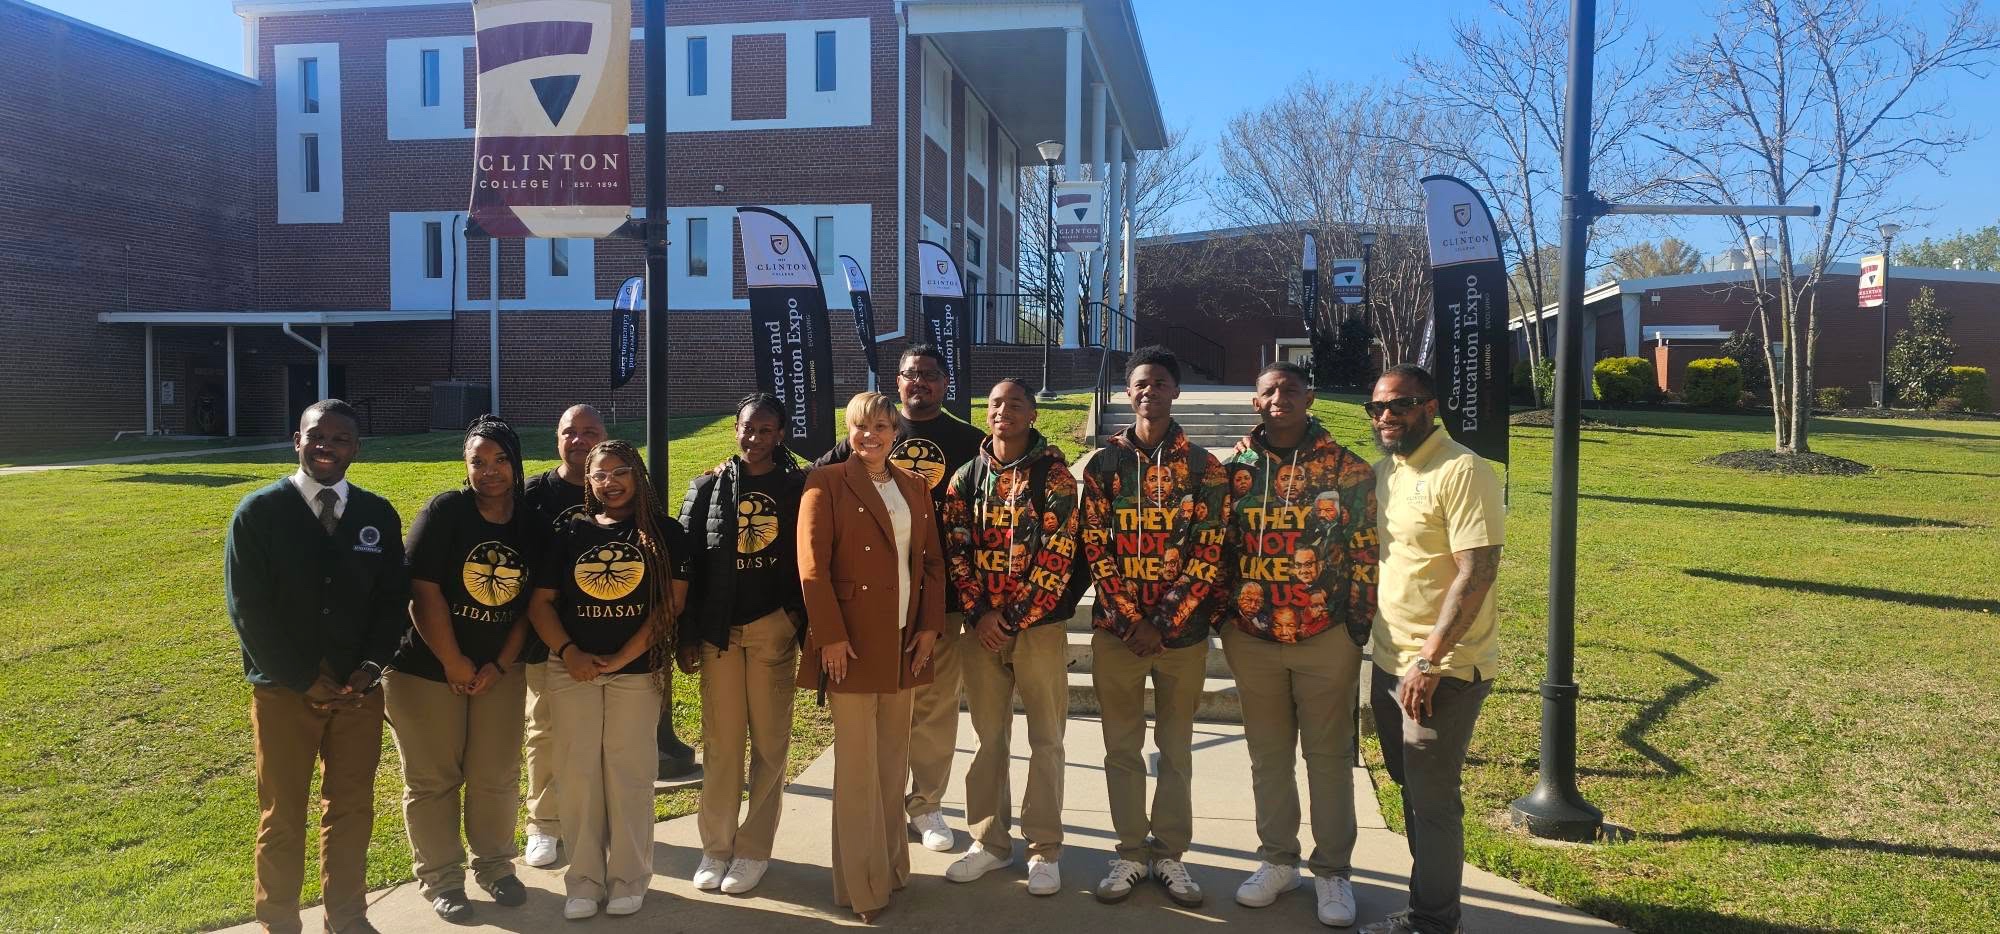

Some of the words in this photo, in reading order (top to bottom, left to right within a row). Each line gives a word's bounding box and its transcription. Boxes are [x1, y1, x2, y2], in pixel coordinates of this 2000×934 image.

[479, 154, 619, 171] CLINTON
[480, 180, 550, 189] COLLEGE
[1442, 234, 1490, 247] CLINTON
[757, 263, 808, 271] CLINTON
[1464, 274, 1482, 326] Expo
[786, 298, 803, 344] Expo
[944, 304, 954, 336] Expo
[1448, 302, 1462, 339] and
[621, 314, 630, 355] Education
[765, 320, 782, 354] and
[772, 358, 786, 405] areer
[1448, 346, 1461, 411] Career
[1462, 332, 1478, 432] Education
[788, 348, 807, 438] Education
[1116, 508, 1180, 530] THEY
[1243, 506, 1312, 530] THEY
[1116, 532, 1170, 556] NOT
[1244, 532, 1302, 555] NOT
[1124, 556, 1162, 580] IKE
[1239, 554, 1291, 582] LIKE
[1270, 583, 1312, 607] US
[576, 604, 644, 618] LIBASAY
